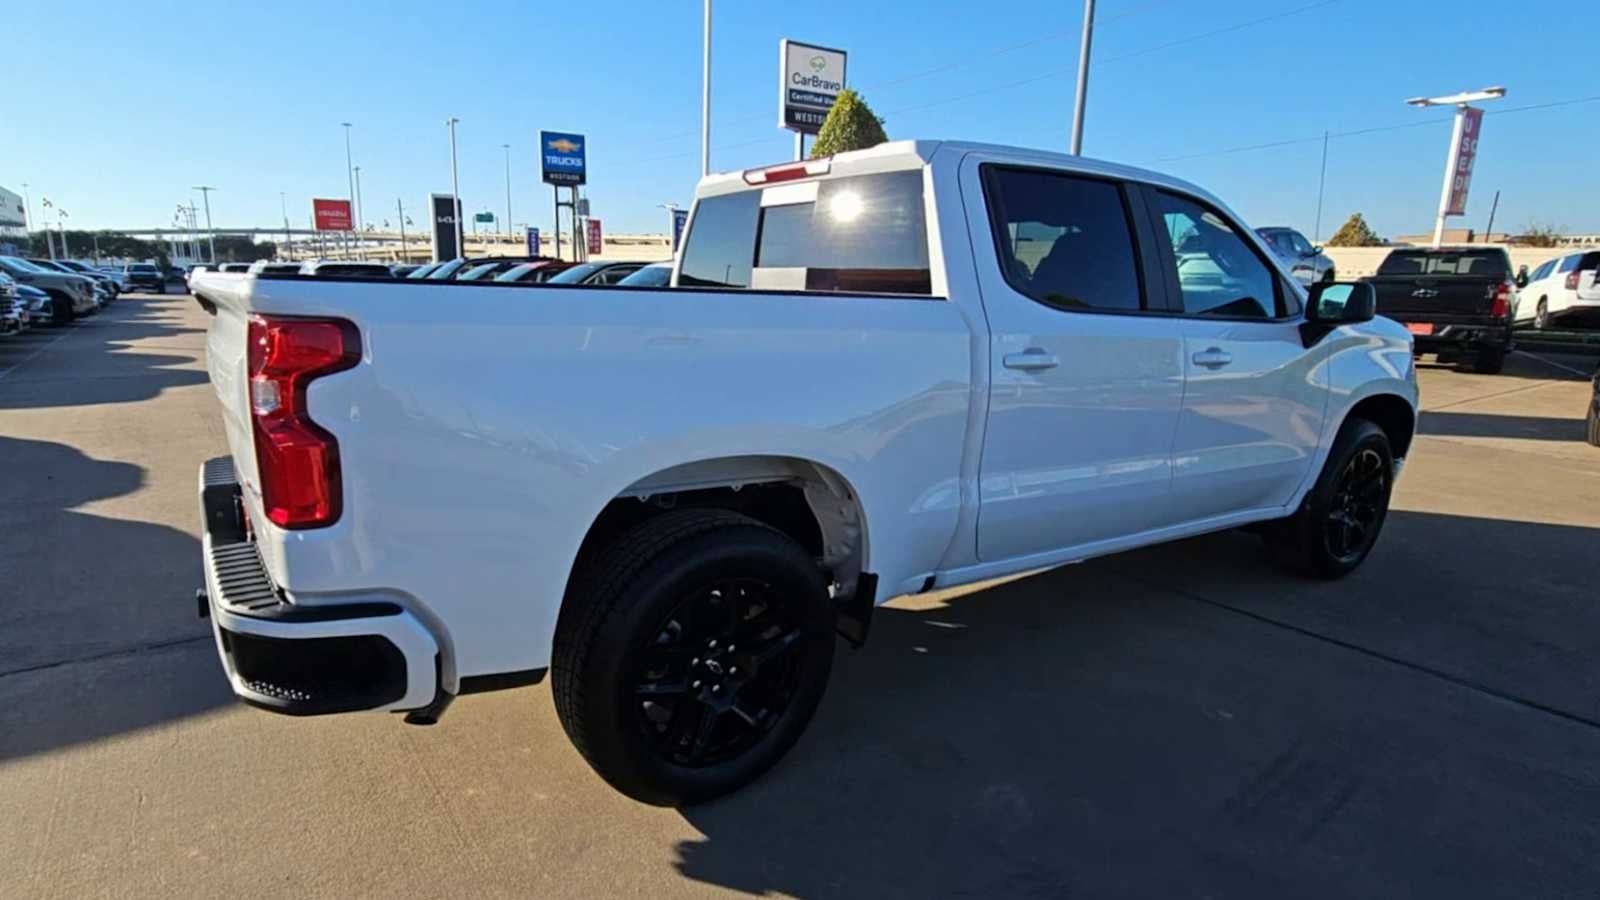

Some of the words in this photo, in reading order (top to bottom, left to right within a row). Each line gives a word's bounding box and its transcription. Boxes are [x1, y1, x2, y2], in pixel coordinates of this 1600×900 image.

[792, 72, 841, 91] CarBravo
[794, 112, 824, 124] WESTS
[545, 156, 583, 166] TRUCKS
